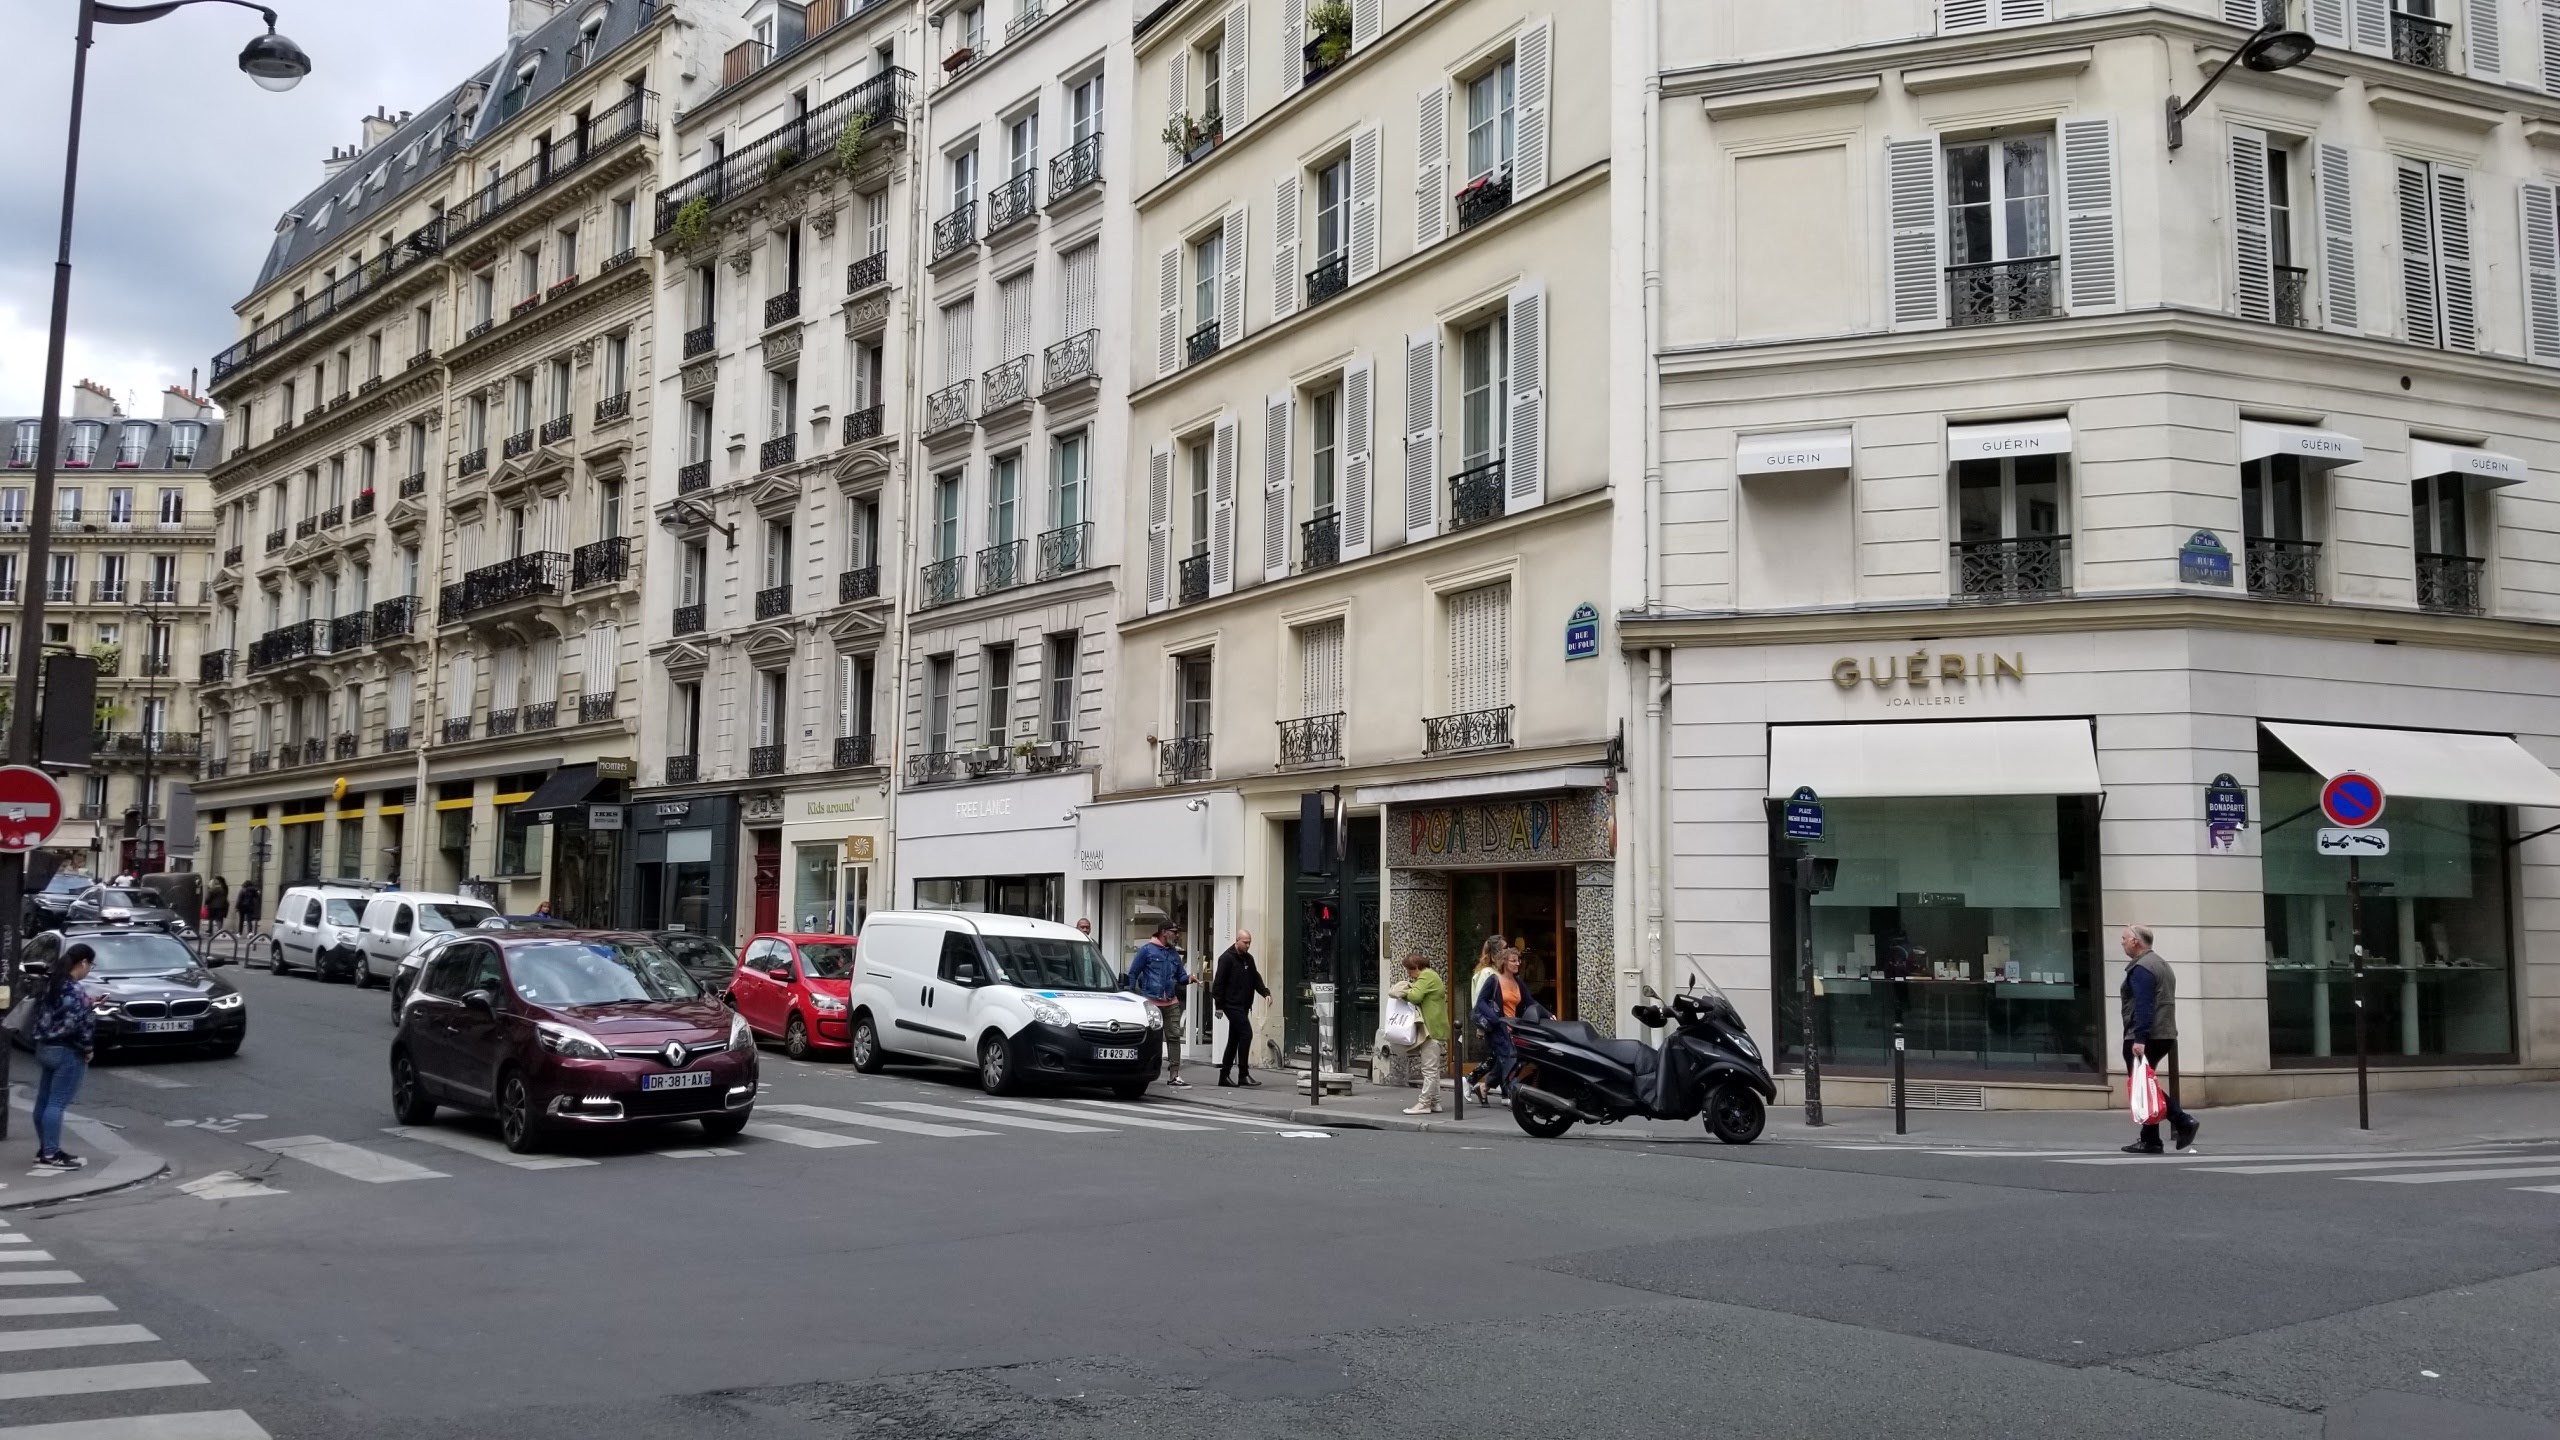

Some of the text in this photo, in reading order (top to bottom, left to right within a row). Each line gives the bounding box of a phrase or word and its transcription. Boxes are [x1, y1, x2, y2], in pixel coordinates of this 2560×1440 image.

[1981, 438, 2039, 451] GUÉRIN
[2301, 439, 2342, 452] GUÉRIN
[2471, 459, 2509, 472] GUÉRIN
[2197, 556, 2215, 567] RUE
[1575, 631, 1589, 640] RUE
[1568, 639, 1595, 651] DU FOUR
[1832, 648, 2024, 689] GUÉRIN
[1886, 695, 1966, 707] JOAILLERIE
[2220, 794, 2234, 803] RUE
[656, 802, 690, 816] IKKS
[807, 799, 855, 815] Kids around
[956, 798, 1011, 819] FREE LANCE
[2209, 803, 2245, 812] BONAPARTE
[1410, 806, 1467, 855] POM
[1080, 850, 1104, 861] DIAMAN
[1080, 860, 1104, 871] TISSIMO
[1126, 1049, 1134, 1059] JS
[650, 1073, 704, 1089] DR-381-AX
